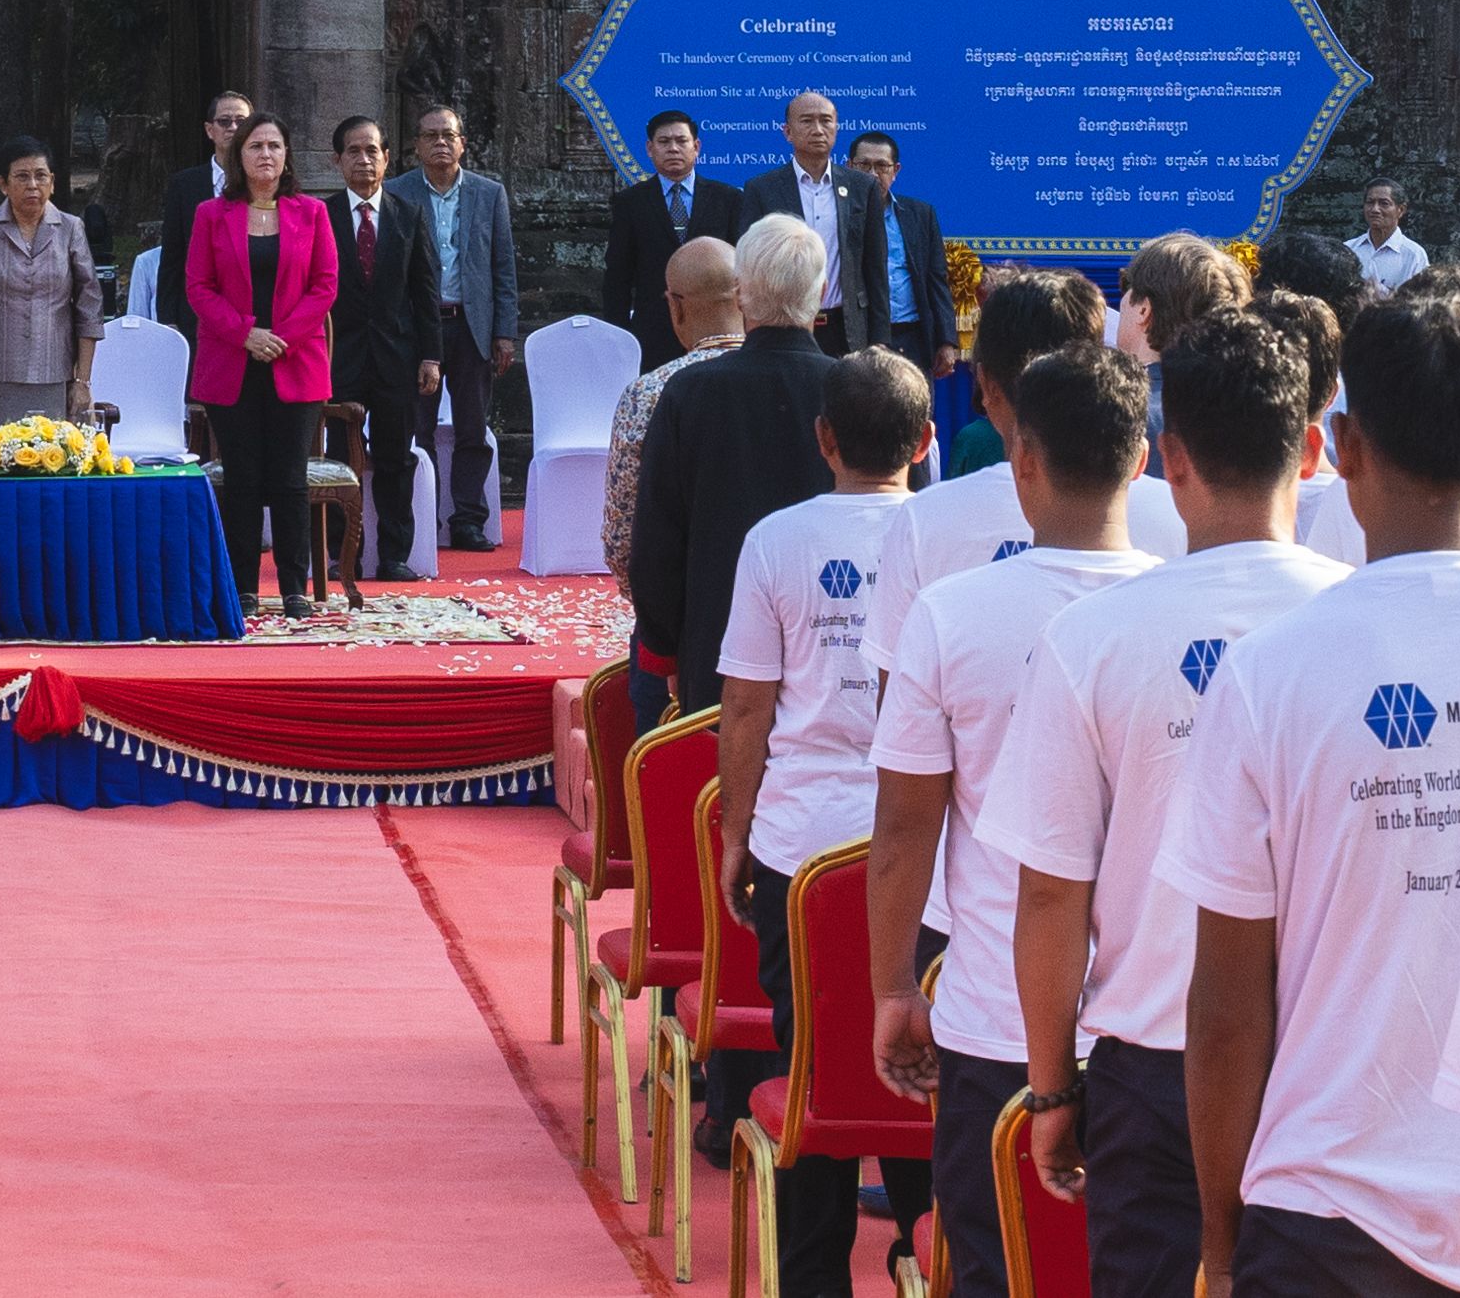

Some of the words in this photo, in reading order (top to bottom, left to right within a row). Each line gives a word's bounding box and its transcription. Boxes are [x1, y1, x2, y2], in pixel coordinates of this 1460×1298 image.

[740, 18, 836, 36] Celebrating
[659, 53, 681, 64] The
[684, 52, 734, 64] handover
[738, 53, 794, 66] Ceremony
[798, 52, 810, 63] of
[813, 52, 888, 63] Conservation
[891, 52, 911, 62] and
[655, 86, 717, 97] Restoration
[720, 86, 742, 97] Site
[745, 87, 755, 97] at
[758, 86, 800, 100] Angkor
[803, 85, 887, 99] Archaeological
[891, 85, 917, 97] Park
[701, 120, 769, 133] Cooperation
[836, 119, 856, 131] orld
[859, 120, 926, 131] Monuments
[709, 153, 730, 164] and
[733, 153, 787, 165] APSARA
[829, 633, 841, 647] the
[843, 634, 862, 651] King
[1350, 773, 1422, 801] Celebrating
[1424, 769, 1460, 792] World
[1376, 809, 1388, 830] in
[1391, 809, 1411, 829] the
[1405, 870, 1453, 896] January
